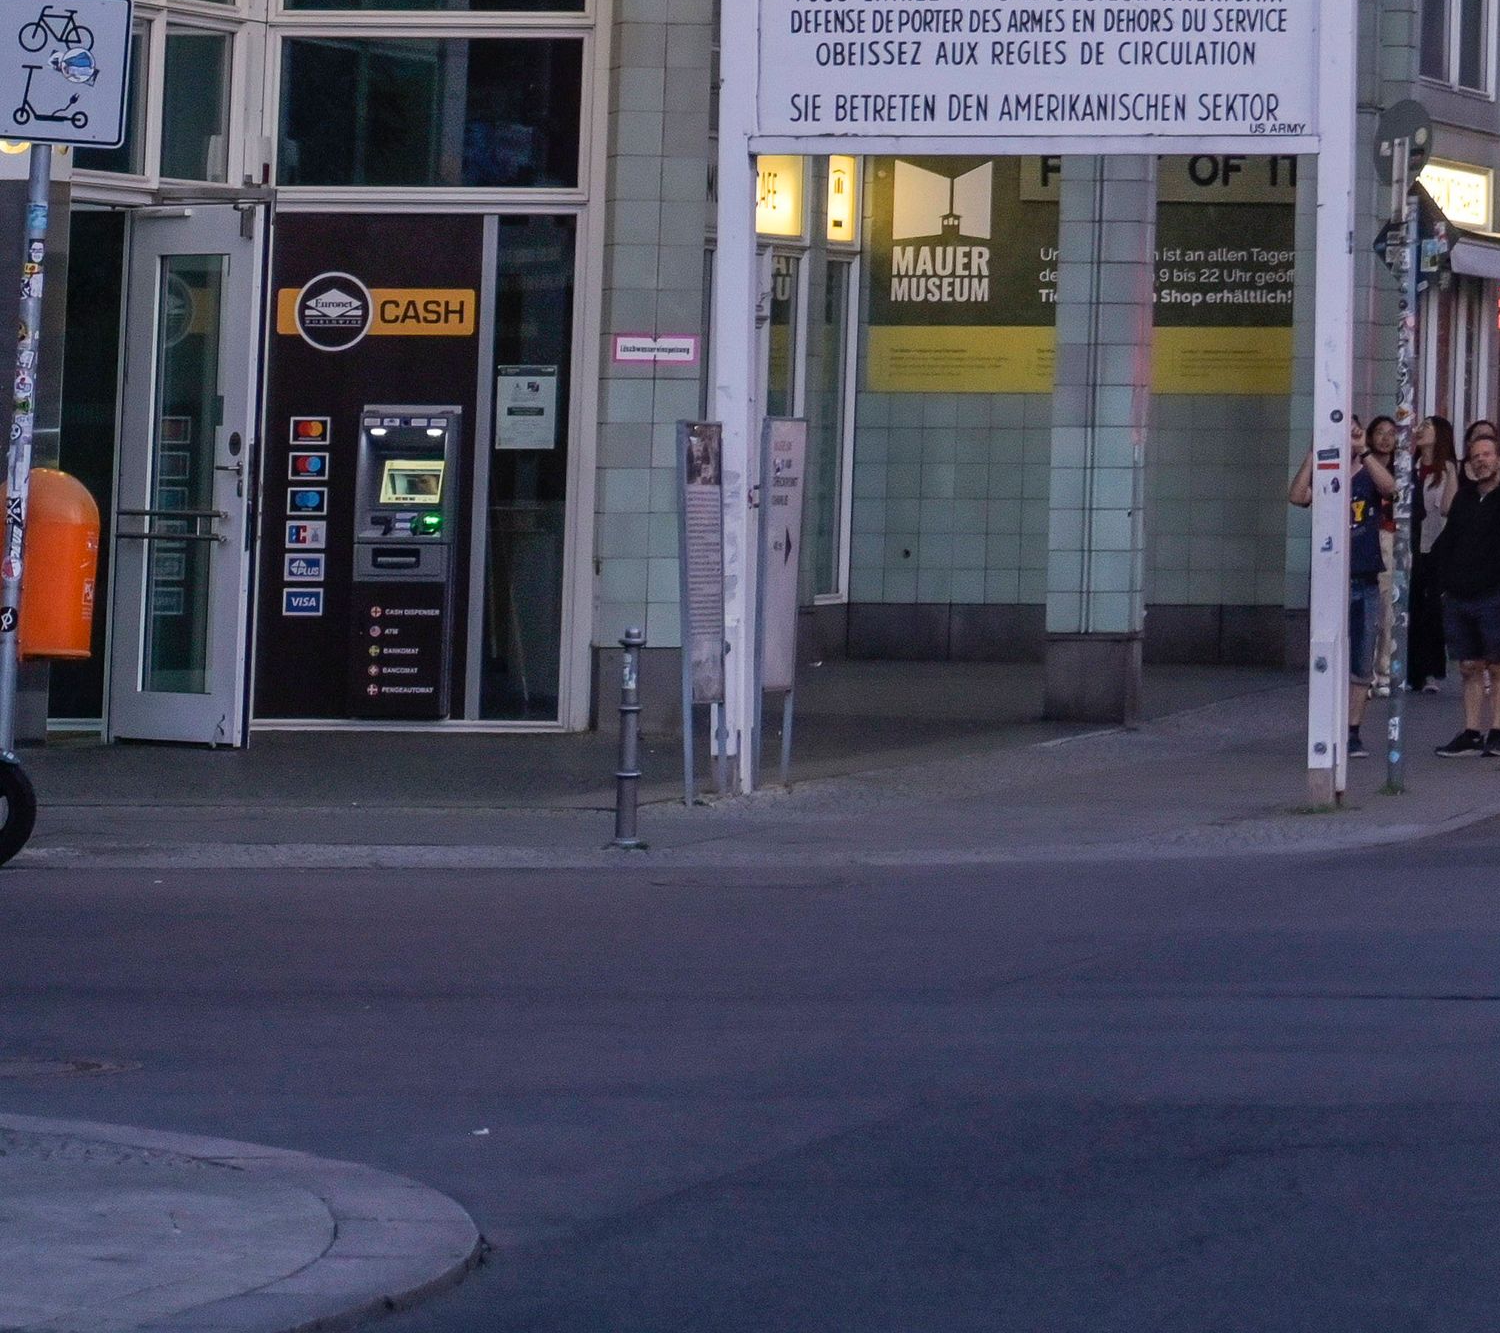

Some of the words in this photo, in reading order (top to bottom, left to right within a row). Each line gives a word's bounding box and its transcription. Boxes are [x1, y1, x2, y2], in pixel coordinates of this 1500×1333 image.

[790, 8, 866, 34] DEFENSE
[872, 9, 894, 34] DE
[898, 8, 964, 34] PORTER
[968, 8, 1002, 34] DES
[1006, 8, 1066, 33] ARMES
[1072, 8, 1096, 33] EN
[1103, 7, 1174, 33] DEHORS
[1181, 8, 1207, 33] DU
[1212, 7, 1288, 33] SERVICE
[815, 40, 922, 67] OBEISSEZ
[935, 41, 979, 66] AUX
[991, 39, 1067, 66] REGLES
[1080, 41, 1105, 66] DE
[1117, 40, 1256, 66] CIRCULATION
[789, 93, 821, 123] SIE
[835, 93, 936, 122] BETRETEN
[948, 93, 989, 122] DEN
[998, 92, 1186, 122] AMERIKANISCHEN
[1197, 92, 1280, 122] SEKTOR
[1249, 123, 1266, 134] US
[1269, 123, 1306, 134] ARMY
[1188, 154, 1247, 187] OF
[892, 245, 991, 276] MAUER
[1163, 248, 1181, 261] ist
[1185, 251, 1205, 261] an
[1208, 248, 1247, 261] allen
[1173, 268, 1197, 282] bis
[1200, 269, 1219, 282] 22
[1224, 268, 1252, 282] Uhr
[891, 277, 989, 302] MUSEUM
[1160, 290, 1202, 307] Shop
[1205, 288, 1292, 304] erhältlich!
[313, 297, 355, 310] Euronet
[379, 299, 464, 325] CASH
[291, 597, 317, 607] VISA
